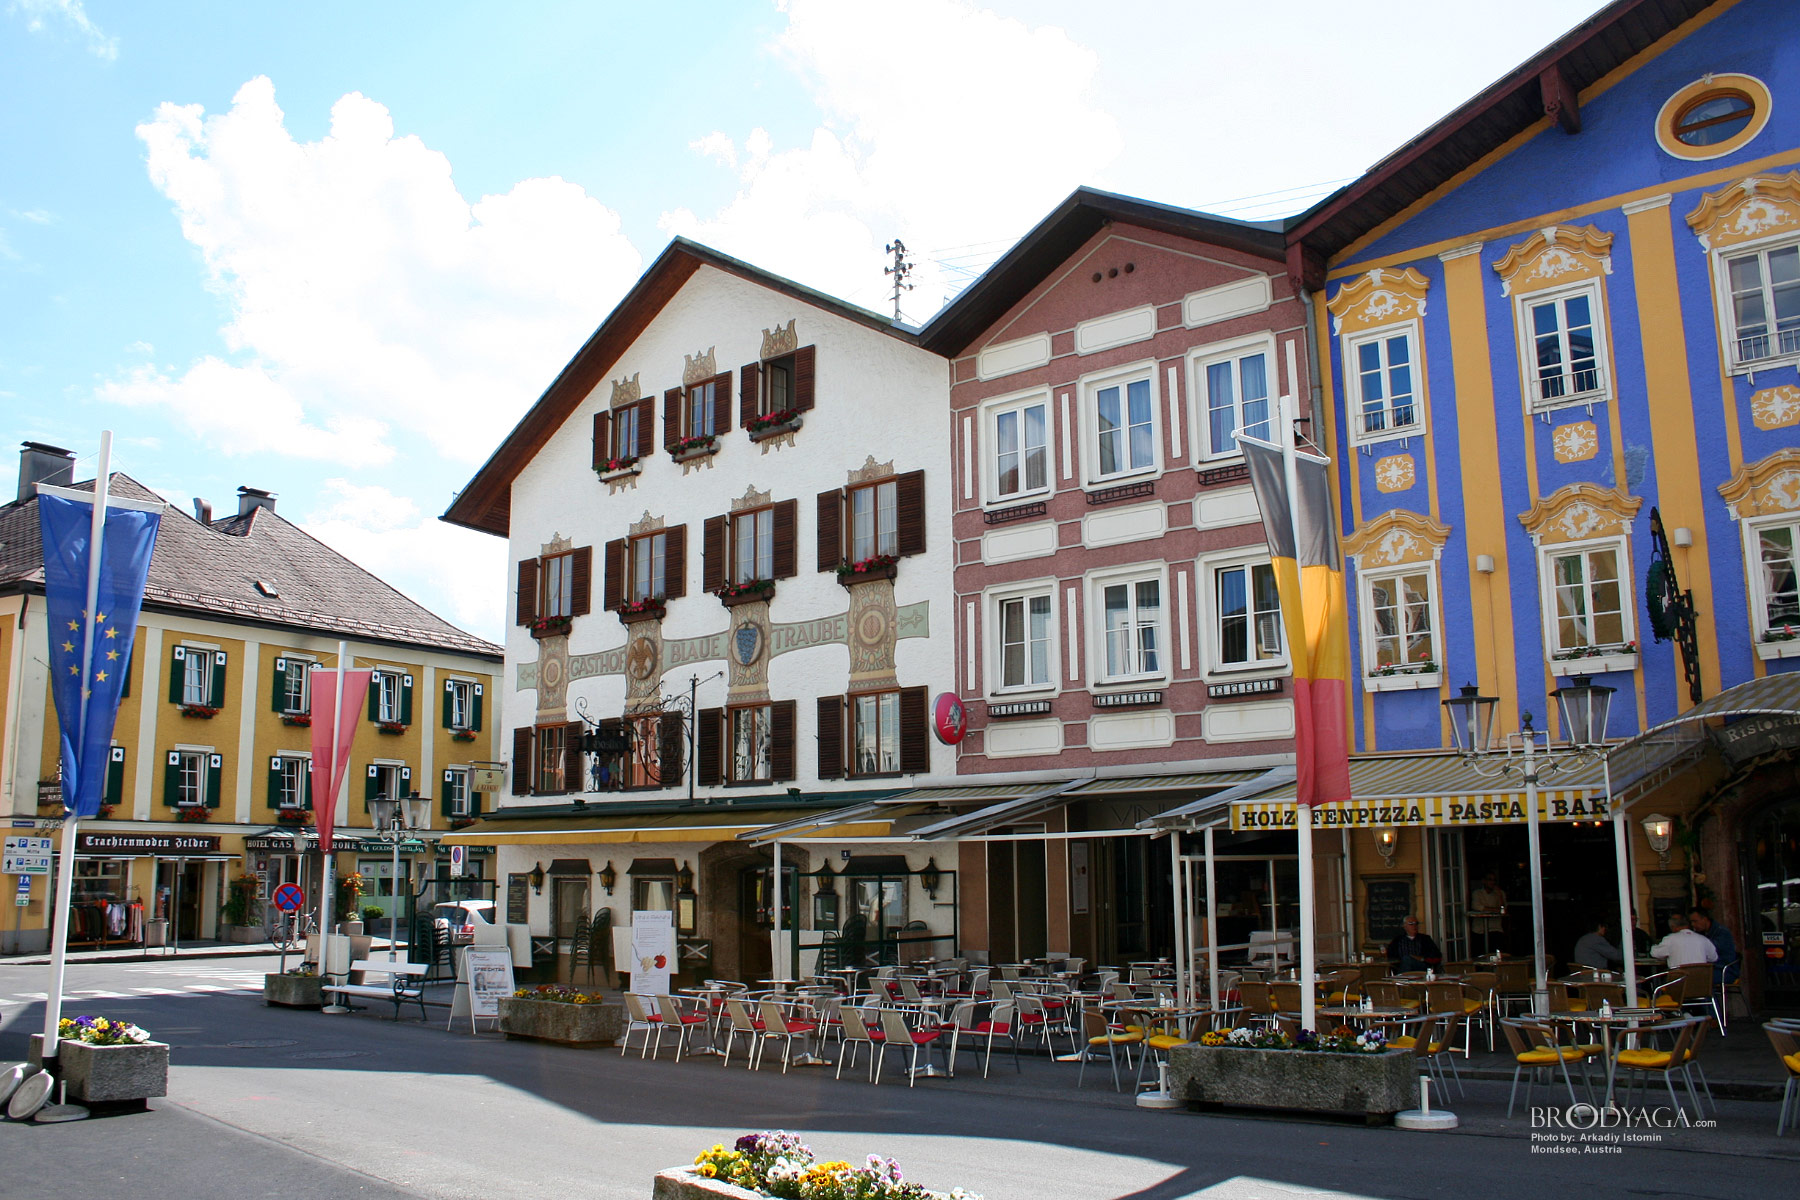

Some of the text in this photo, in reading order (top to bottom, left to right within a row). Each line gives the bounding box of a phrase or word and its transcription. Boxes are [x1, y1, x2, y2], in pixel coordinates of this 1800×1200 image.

[570, 617, 845, 676] GASTHOF BLAUE TRAUBE
[1242, 805, 1424, 827] HOLZFENPIZZA
[1449, 801, 1526, 820] PASTA
[1552, 797, 1609, 817] BAR
[85, 836, 170, 848] Trachtenmoden
[247, 839, 357, 850] HOTEL GASOF RONE
[372, 844, 413, 852] GOLDSMIED
